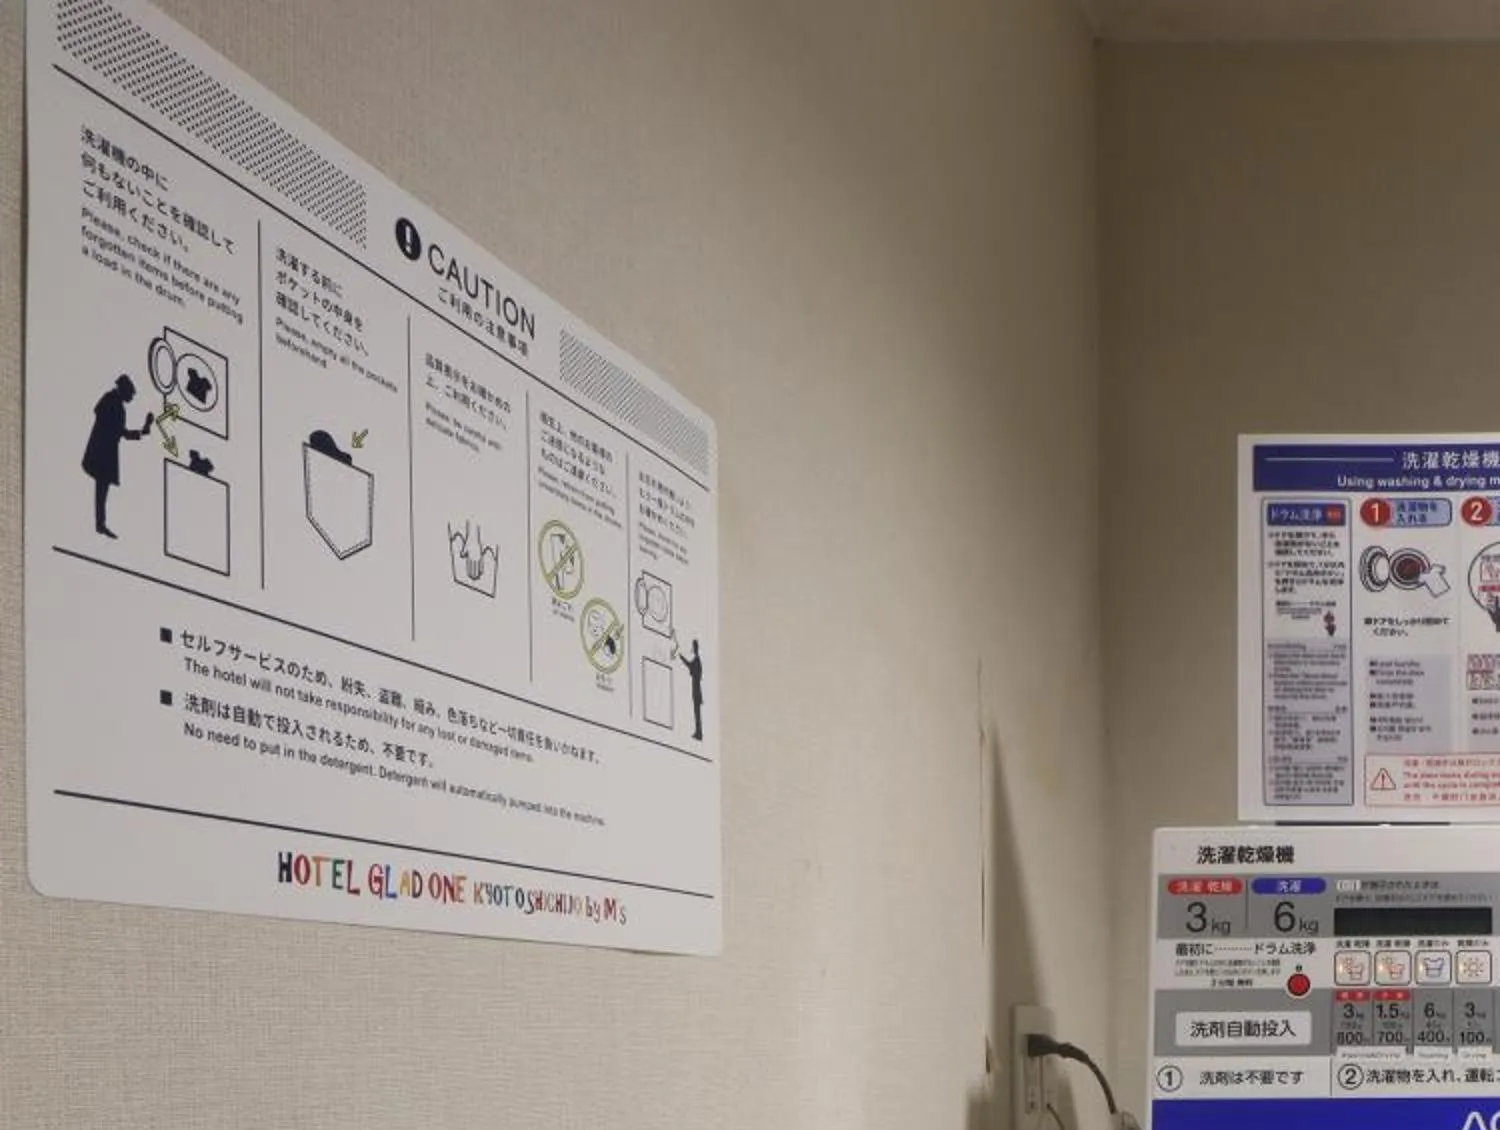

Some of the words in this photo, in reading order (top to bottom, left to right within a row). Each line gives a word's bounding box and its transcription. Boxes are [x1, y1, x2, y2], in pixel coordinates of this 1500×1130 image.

[428, 244, 535, 340] CAUTION
[1337, 475, 1375, 490] Using
[1377, 475, 1431, 490] washing
[1434, 476, 1443, 488] &
[1446, 475, 1486, 490] drying
[1371, 502, 1380, 523] 1
[1470, 501, 1483, 521] 2
[184, 656, 210, 677] The
[213, 665, 248, 686] hotel
[250, 676, 271, 693] will
[275, 684, 296, 701] not
[298, 689, 323, 707] take
[325, 698, 398, 729] responsibility
[401, 715, 416, 732] for
[417, 723, 435, 740] any
[437, 727, 456, 742] lost
[457, 734, 468, 746] or
[184, 692, 433, 768] 洗剤は自動で投入されるため、不要です。
[184, 722, 202, 740] No
[207, 728, 240, 748] need
[243, 735, 257, 751] to
[259, 741, 281, 756] put
[283, 744, 295, 760] in
[299, 748, 317, 764] the
[319, 752, 377, 778] detergent.
[1197, 845, 1295, 864] 洗濯乾燥機
[277, 851, 360, 895] HOTEL
[367, 863, 423, 901] GLAD
[428, 871, 468, 906] ONE
[585, 896, 602, 924] by
[1190, 1019, 1297, 1039] 洗剤自動投入
[1199, 1070, 1304, 1086] 洗剤は不要です
